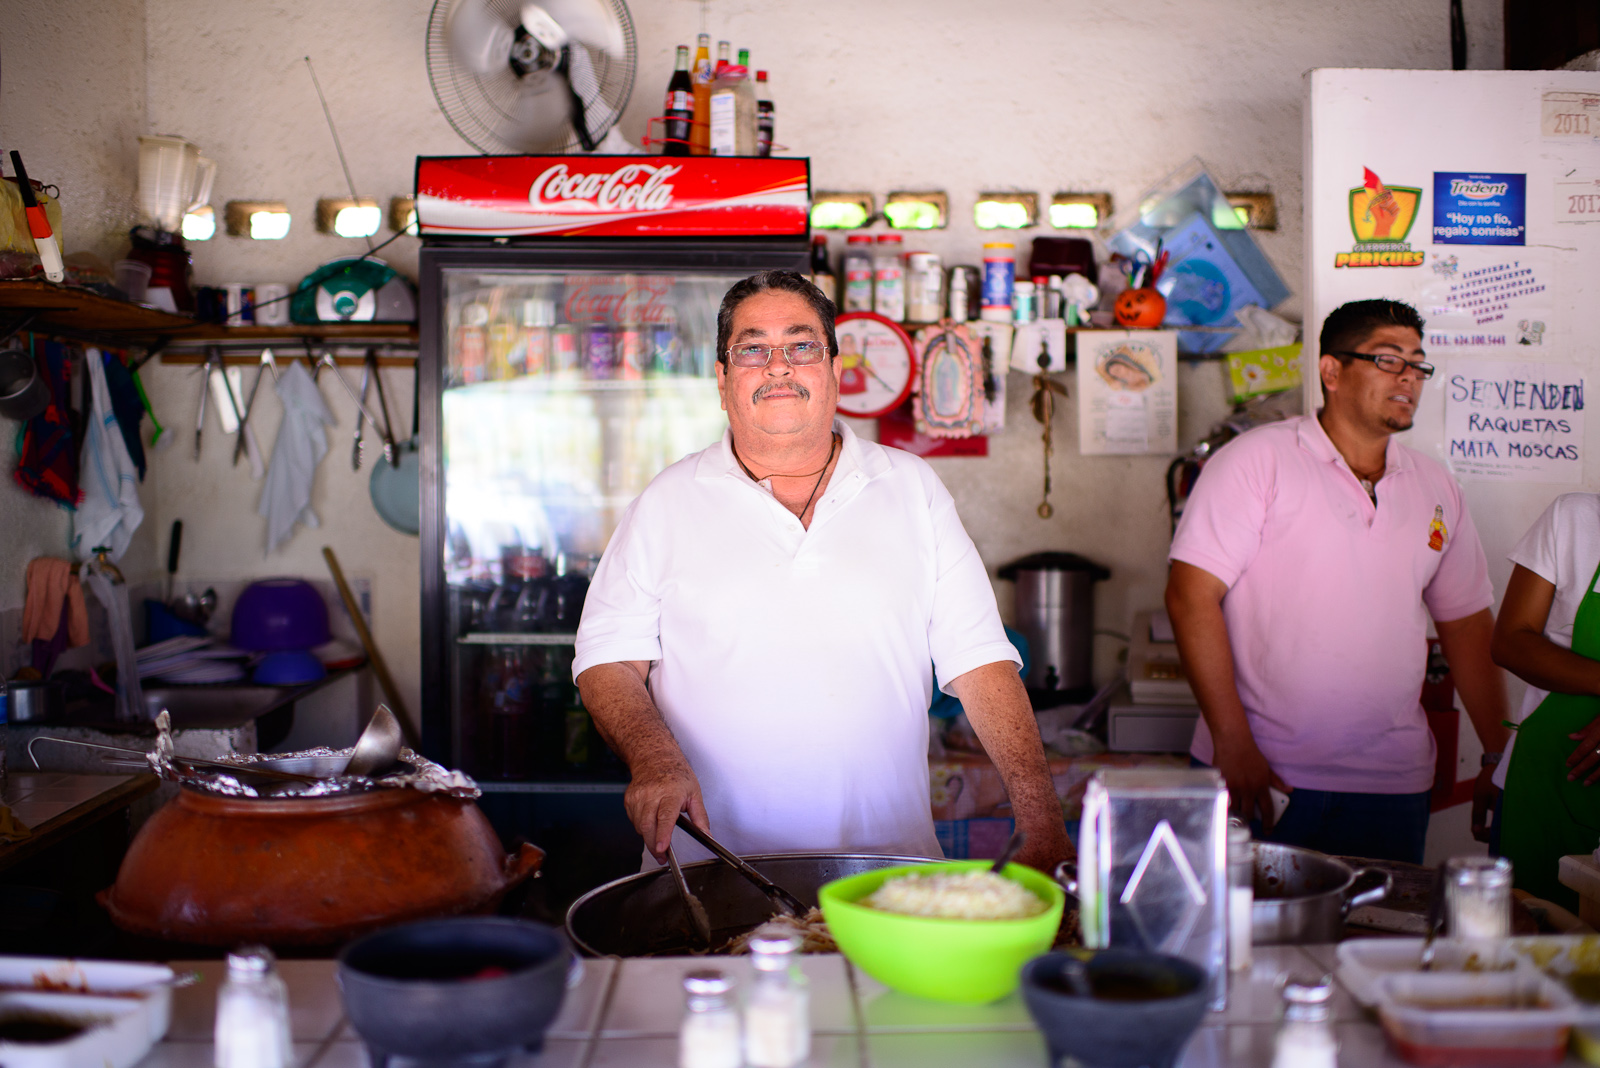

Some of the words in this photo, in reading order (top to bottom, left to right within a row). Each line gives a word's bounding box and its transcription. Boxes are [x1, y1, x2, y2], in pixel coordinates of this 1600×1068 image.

[1554, 115, 1591, 133] 2011
[529, 163, 682, 210] Coca-Cola
[1451, 180, 1507, 195] Trident
[1477, 215, 1492, 224] no
[1434, 225, 1470, 238] regalo
[1354, 243, 1410, 252] GUERREROS
[1335, 252, 1424, 268] PERICUES
[1450, 268, 1532, 291] MANTENIMIENTO
[1462, 264, 1510, 279] LIMPIEZA
[1461, 277, 1536, 299] COMPUTADORAS
[564, 286, 668, 322] Coca-Cola
[1451, 375, 1483, 403] SE
[1494, 379, 1584, 411] VENDEN
[1468, 412, 1571, 433] RAQUETAS
[1450, 440, 1499, 458] MATA
[1508, 442, 1578, 461] MOSCAS
